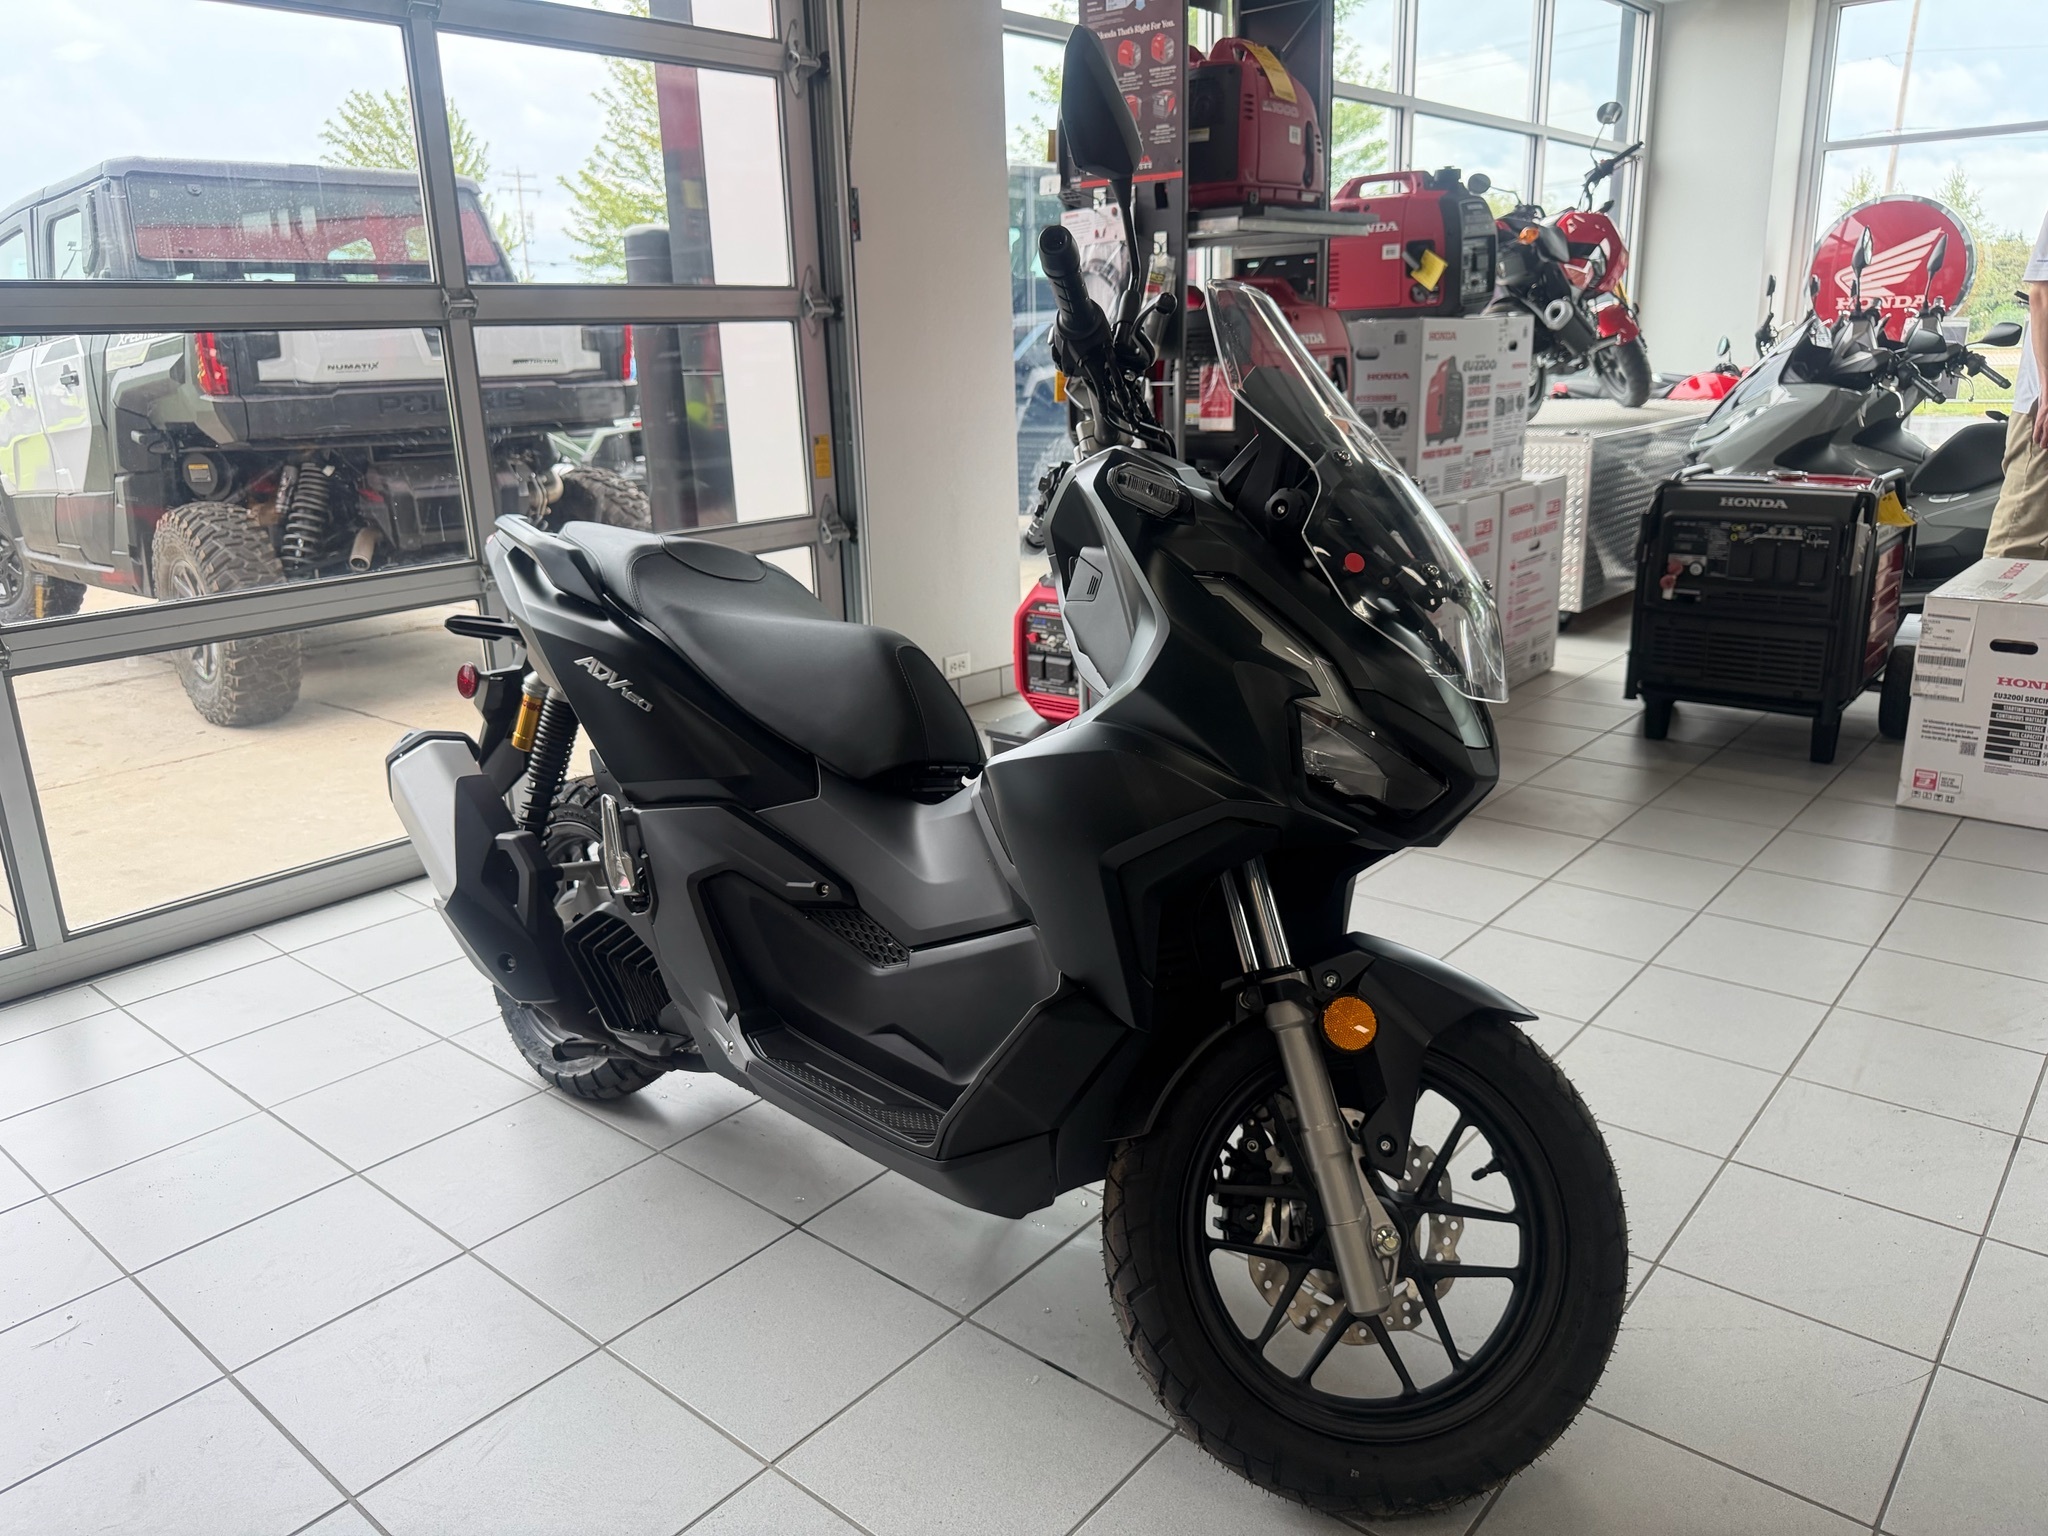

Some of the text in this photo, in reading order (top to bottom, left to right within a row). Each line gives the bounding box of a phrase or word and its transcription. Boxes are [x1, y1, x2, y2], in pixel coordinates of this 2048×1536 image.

[1134, 23, 1151, 34] Right
[1151, 21, 1162, 31] For
[1835, 295, 1931, 310] HONDA
[1428, 331, 1457, 341] HONDA
[327, 361, 379, 371] NUMATIX
[1366, 372, 1410, 381] HONDA
[1719, 496, 1788, 509] HONDA
[574, 656, 653, 712] ADV 160
[1993, 691, 2024, 702] EU3200i
